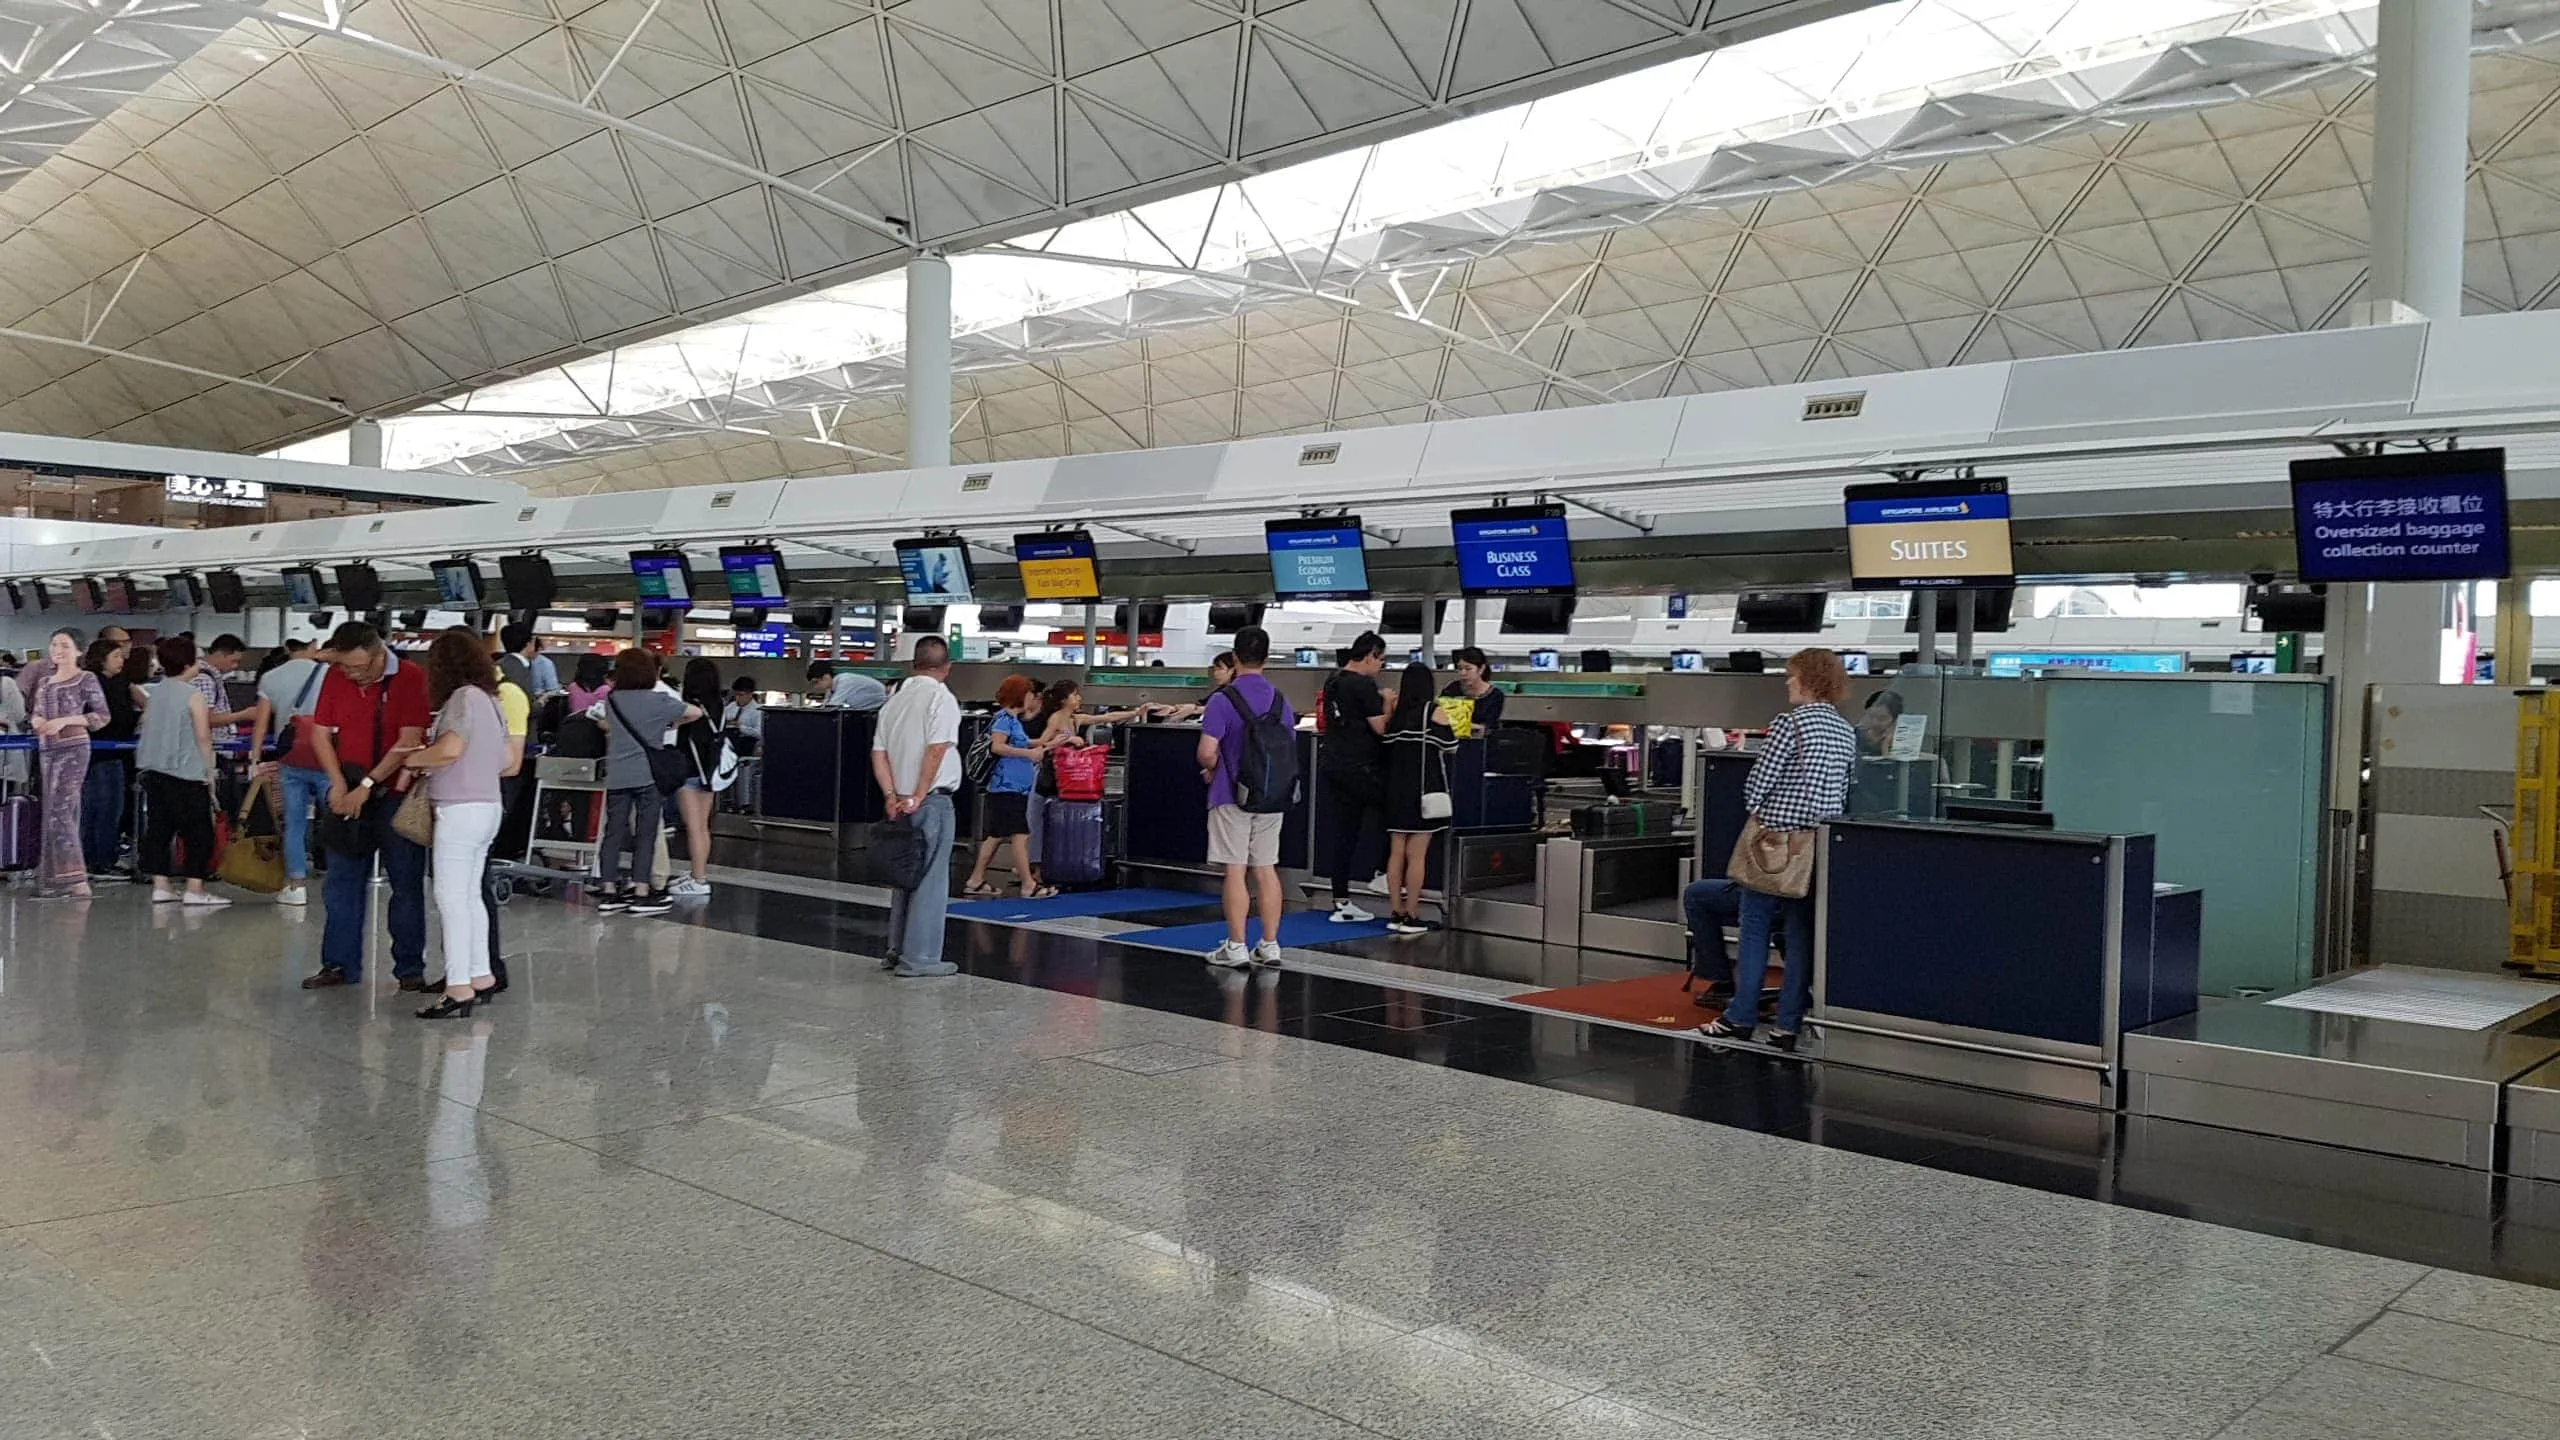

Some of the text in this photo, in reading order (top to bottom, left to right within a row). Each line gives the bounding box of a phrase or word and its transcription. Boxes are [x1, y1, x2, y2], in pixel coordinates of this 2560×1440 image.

[2314, 521, 2486, 539] Oversized baggage
[1890, 539, 1968, 561] SUITES
[2321, 542, 2480, 558] collection counter
[1486, 551, 1538, 564] BUSINESS
[1298, 566, 1336, 576] ECONOMY
[1496, 564, 1532, 577] CLASS
[1306, 576, 1332, 586] CLASS
